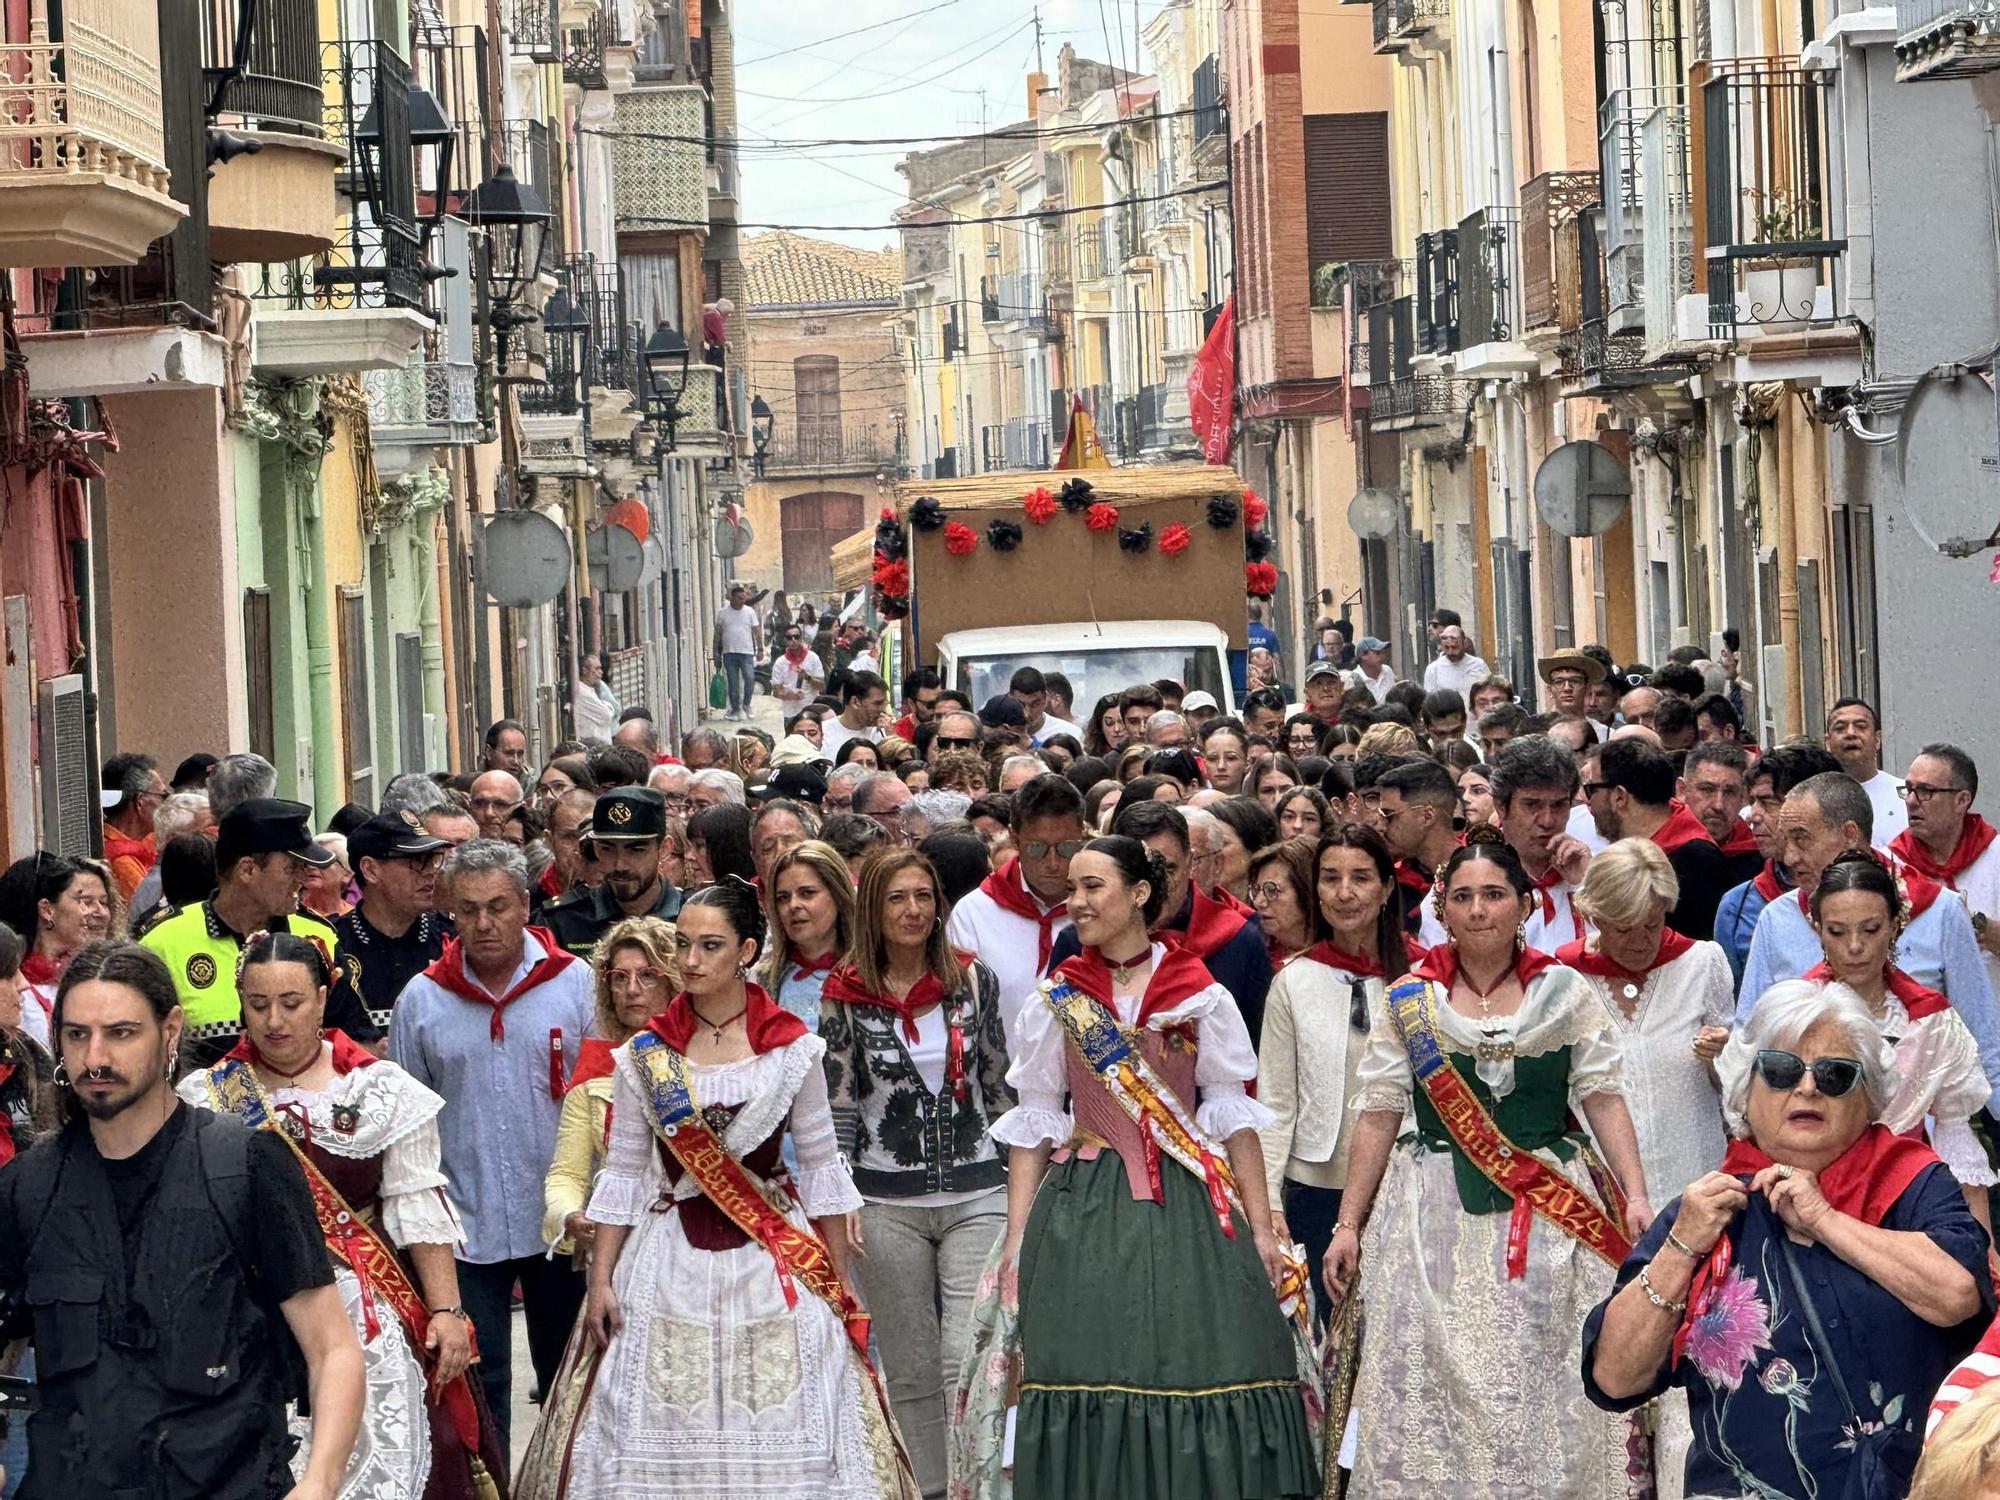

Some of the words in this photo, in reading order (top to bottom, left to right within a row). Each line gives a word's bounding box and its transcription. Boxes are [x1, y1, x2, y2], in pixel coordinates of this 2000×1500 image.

[683, 1140, 761, 1225] Dama
[1438, 1088, 1519, 1178] Dama
[1526, 1175, 1604, 1242] 2024
